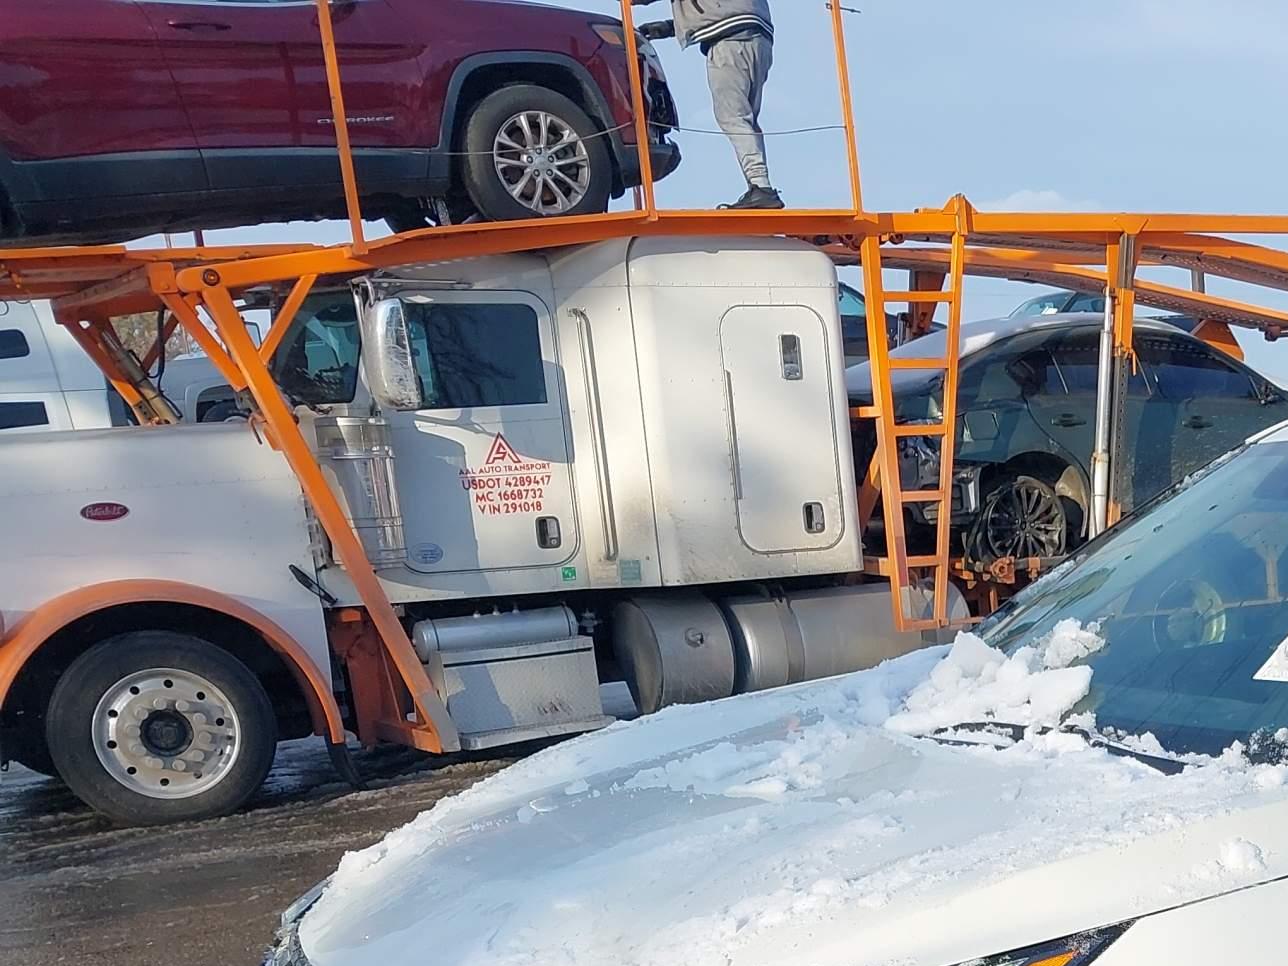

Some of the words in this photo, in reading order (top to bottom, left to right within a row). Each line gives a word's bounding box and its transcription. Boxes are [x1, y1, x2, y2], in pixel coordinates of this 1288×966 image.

[479, 466, 502, 474] AUTO
[504, 463, 550, 472] TRANSPORT
[461, 478, 501, 490] USDOT
[504, 475, 551, 488] 4289417
[475, 491, 495, 503] MC
[497, 488, 544, 501] 1668732
[503, 500, 543, 513] 291018
